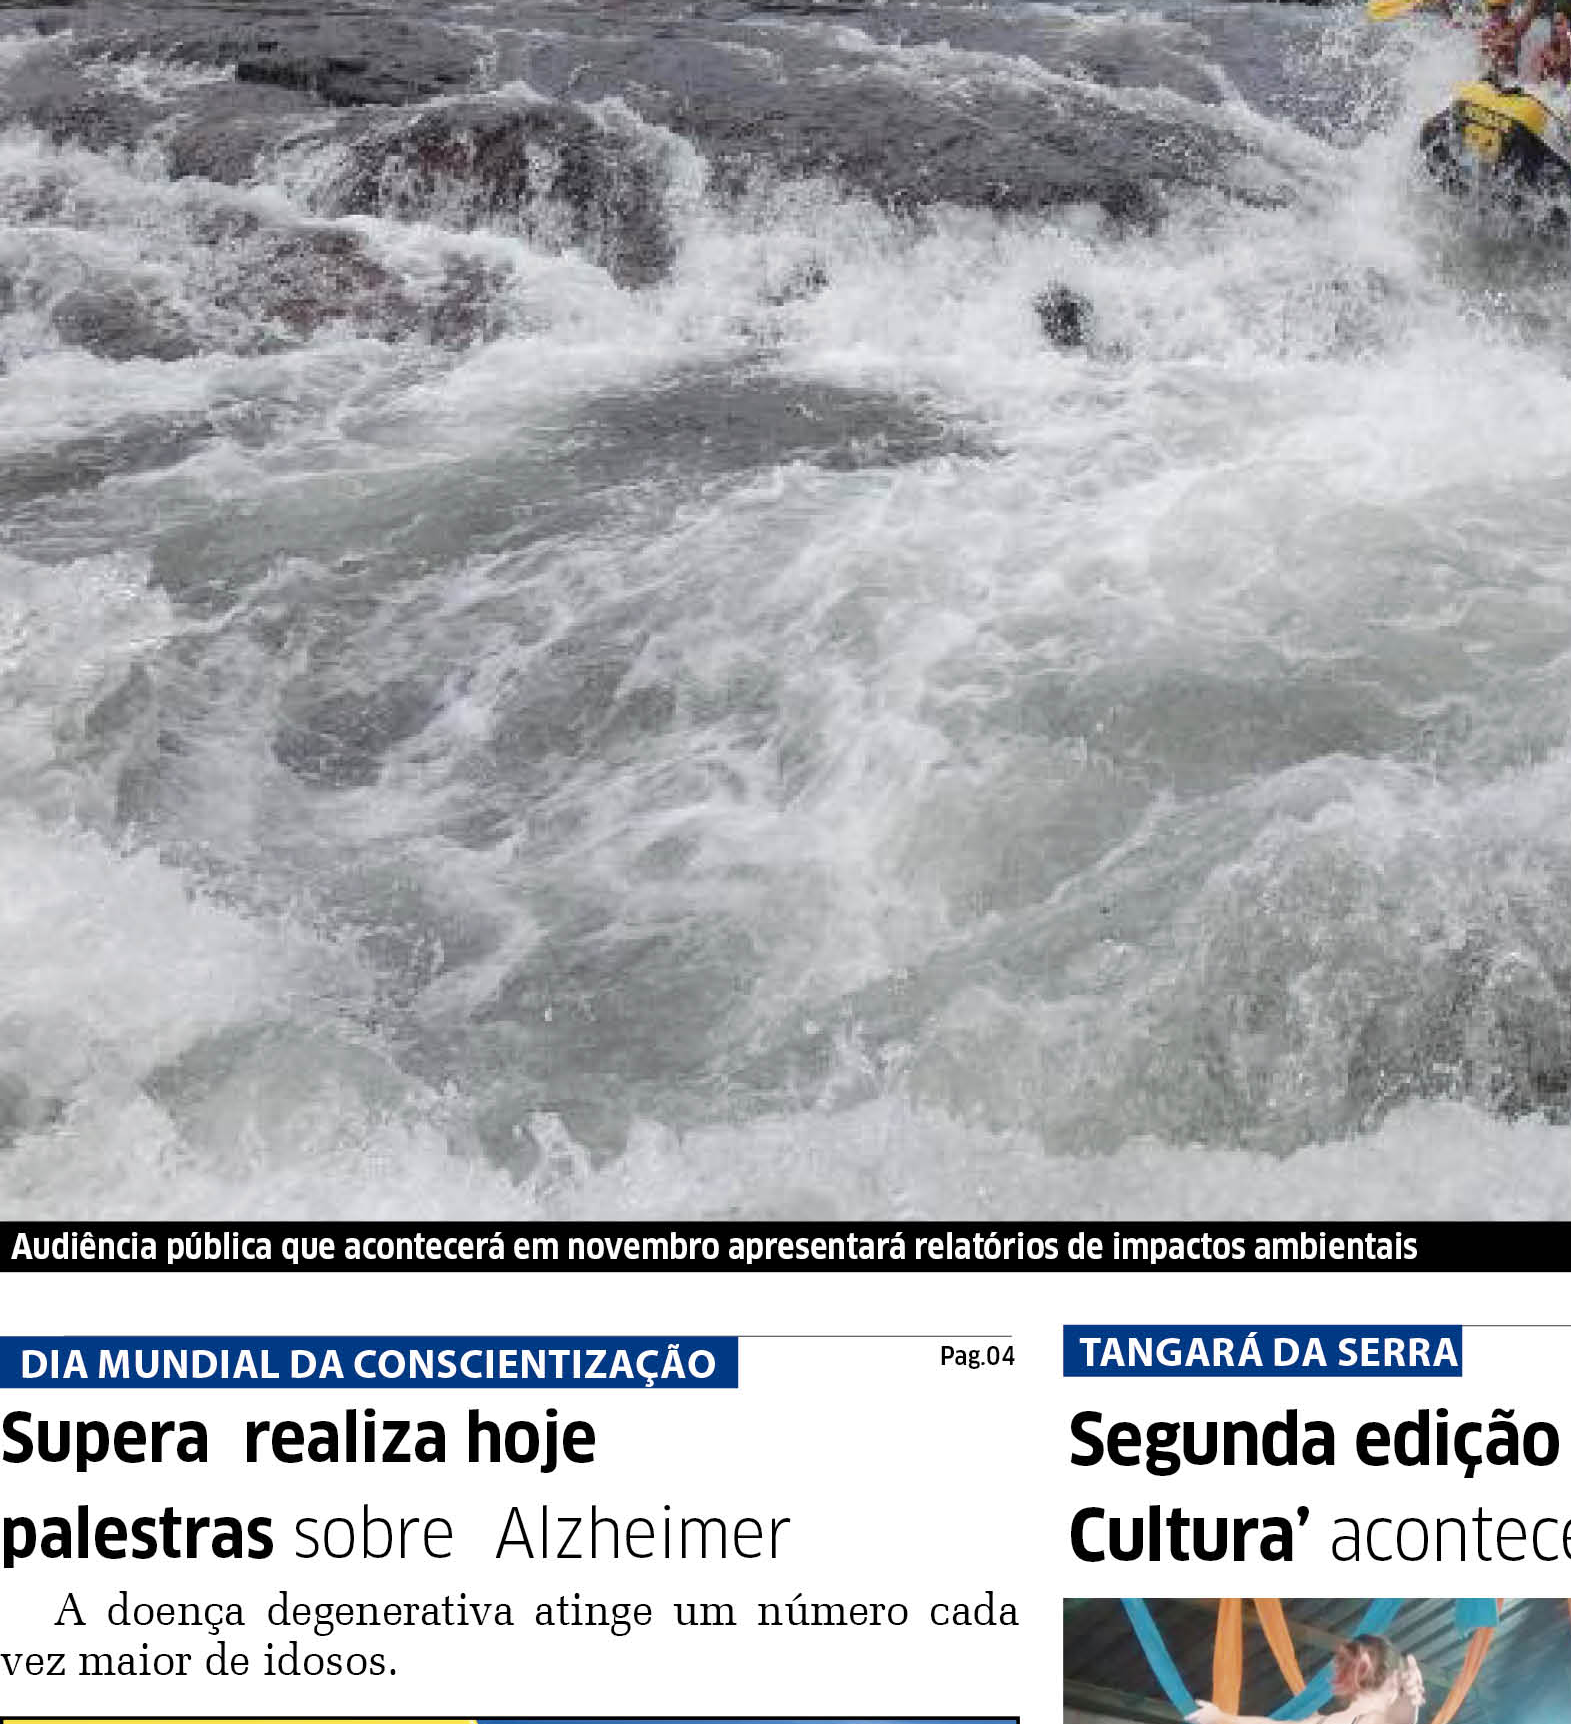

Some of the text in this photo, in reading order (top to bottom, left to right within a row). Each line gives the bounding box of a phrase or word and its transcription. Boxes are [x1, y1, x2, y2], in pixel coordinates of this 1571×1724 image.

[10, 1231, 1418, 1265] Audiência pública que acontecerá em novembro apresentará relatórios de impactos ambientais
[21, 1343, 716, 1388] DIA MUNDIAL DA CONSCIENTIZAÇÃO
[940, 1345, 1016, 1370] Pag.04
[2, 1407, 596, 1474] Supera realiza hoje
[3, 1503, 791, 1569] palestras sobre Alzheimer
[0, 1640, 396, 1676] vez maior de idosos.
